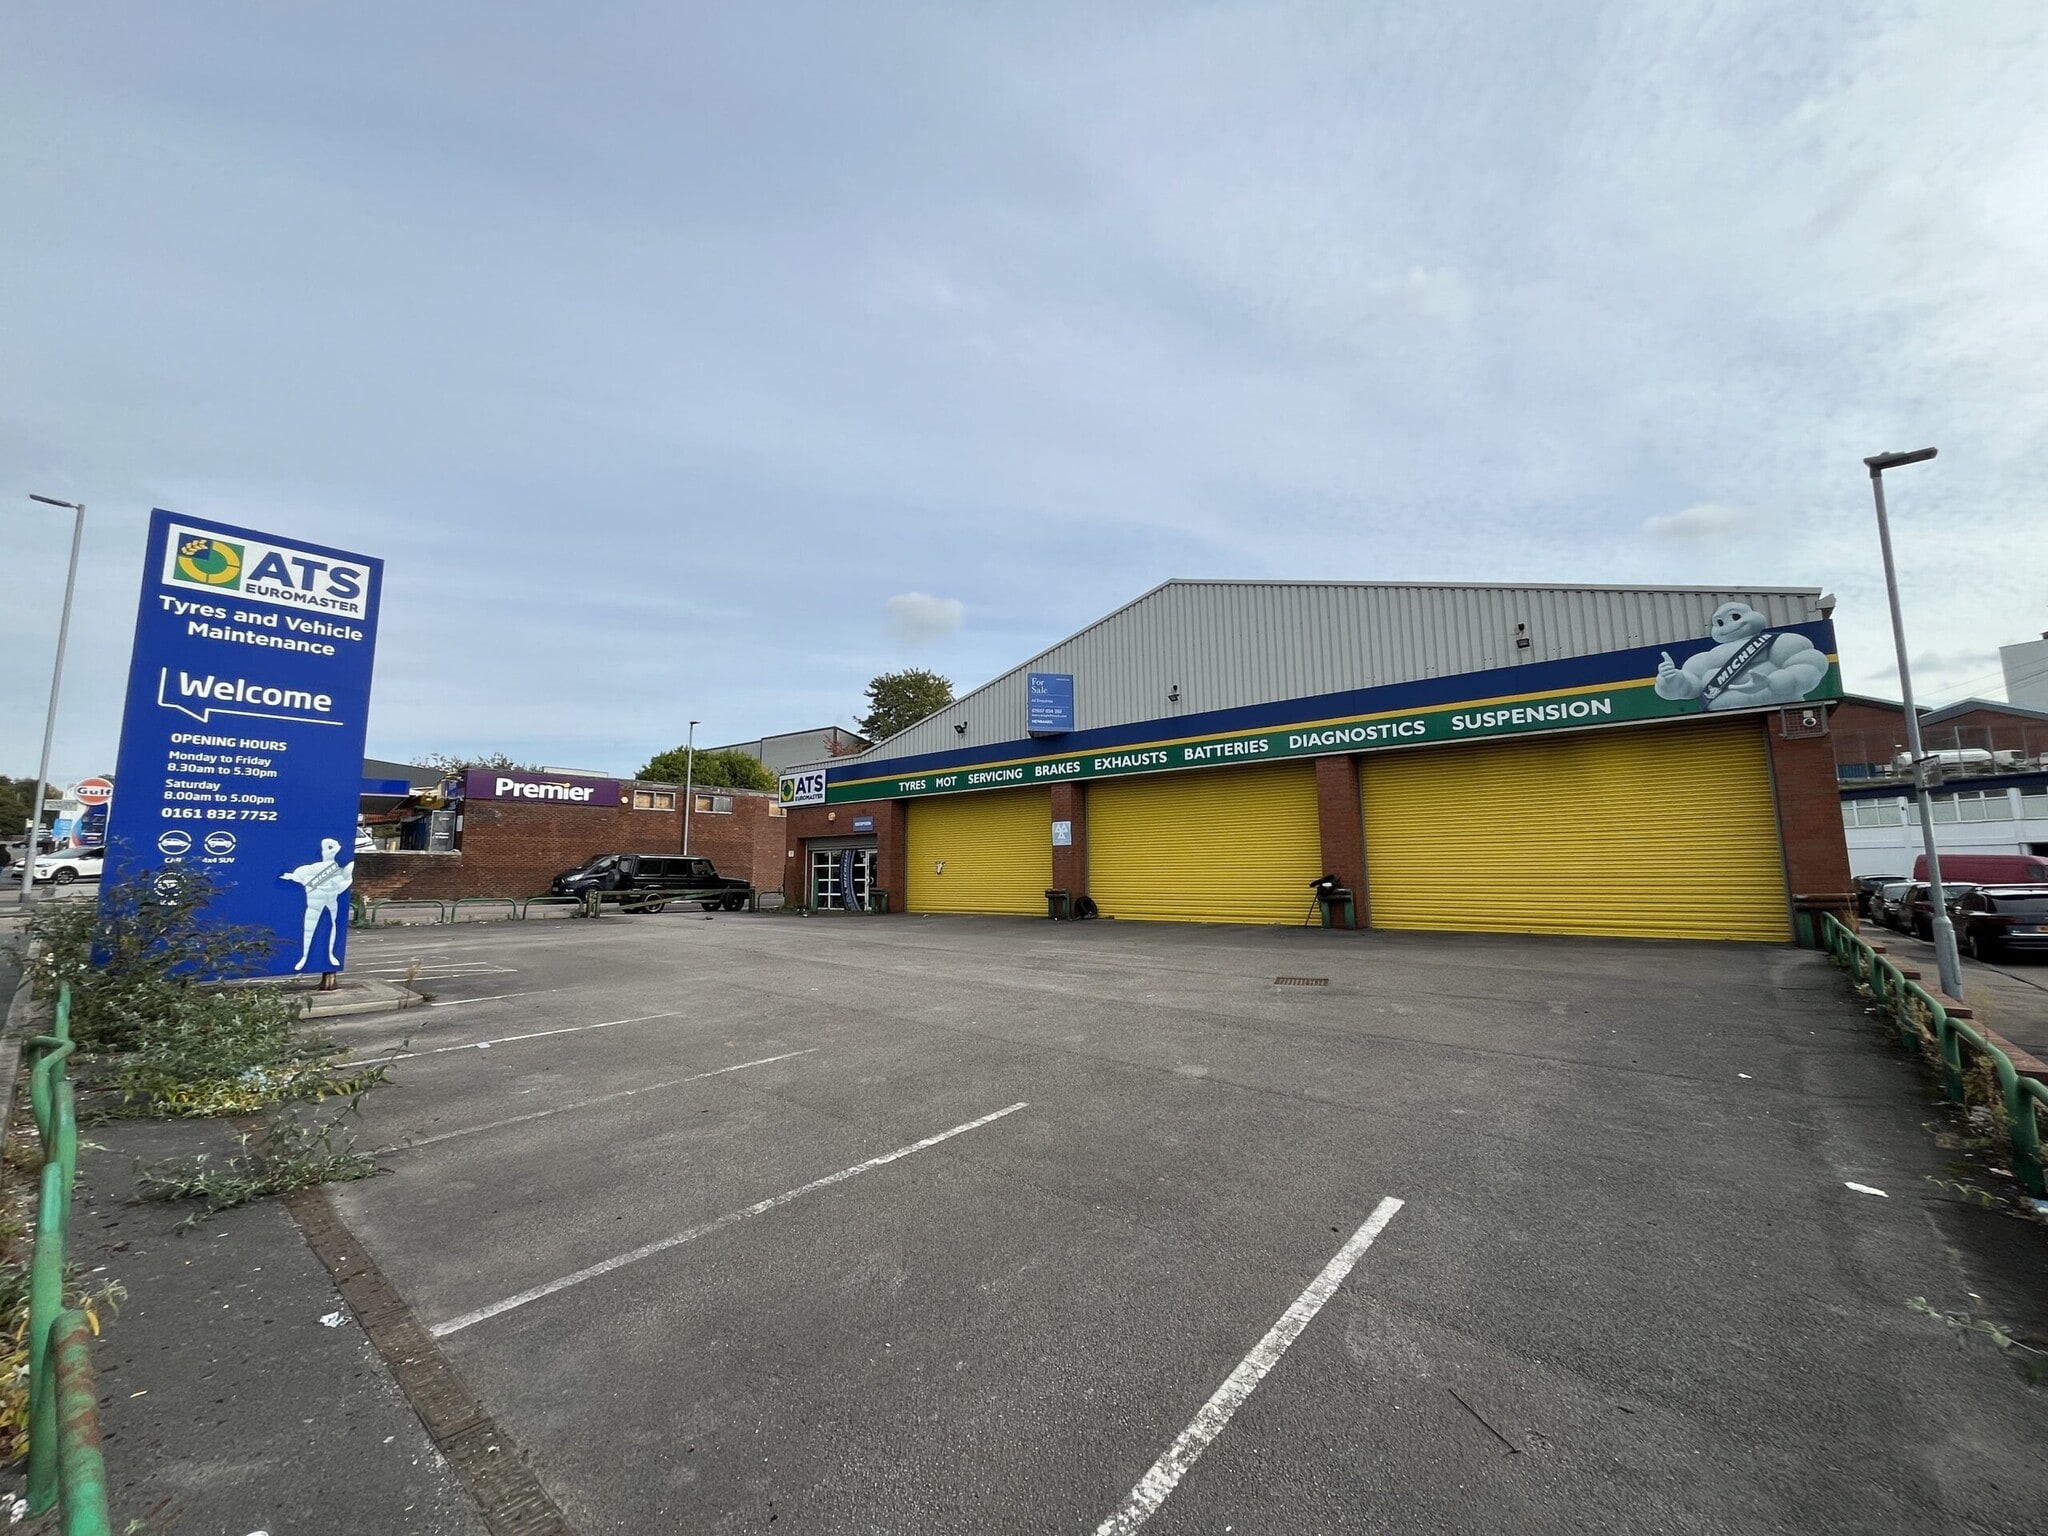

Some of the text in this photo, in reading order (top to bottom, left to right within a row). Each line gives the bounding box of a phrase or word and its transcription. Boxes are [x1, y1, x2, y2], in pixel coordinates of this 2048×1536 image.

[247, 551, 361, 600] ATS
[245, 584, 359, 613] EUROMASTER
[159, 595, 363, 642] Tyres and Vehicle
[187, 622, 335, 656] Maintenance
[1716, 633, 1773, 686] MICHELIN
[179, 671, 332, 712] Welcome
[1032, 686, 1048, 694] Sale
[171, 733, 287, 752] OPENING HOURS
[899, 698, 1612, 792] TYRES MOT SERVICING BRAKES EXHAUSTS BATTERIES DIAGNOSTICS SUSPENSION
[169, 751, 271, 768] Monday to Friday
[167, 763, 277, 778] 8.30am to 5.30pm
[77, 786, 112, 796] Gulf
[165, 778, 220, 791] Saturday
[495, 777, 594, 802] Premier
[795, 774, 823, 795] ATS
[164, 791, 275, 805] 8.00am to 5.00pm
[795, 793, 823, 802] EUROMASTER
[162, 808, 278, 821] 0161 832 7752
